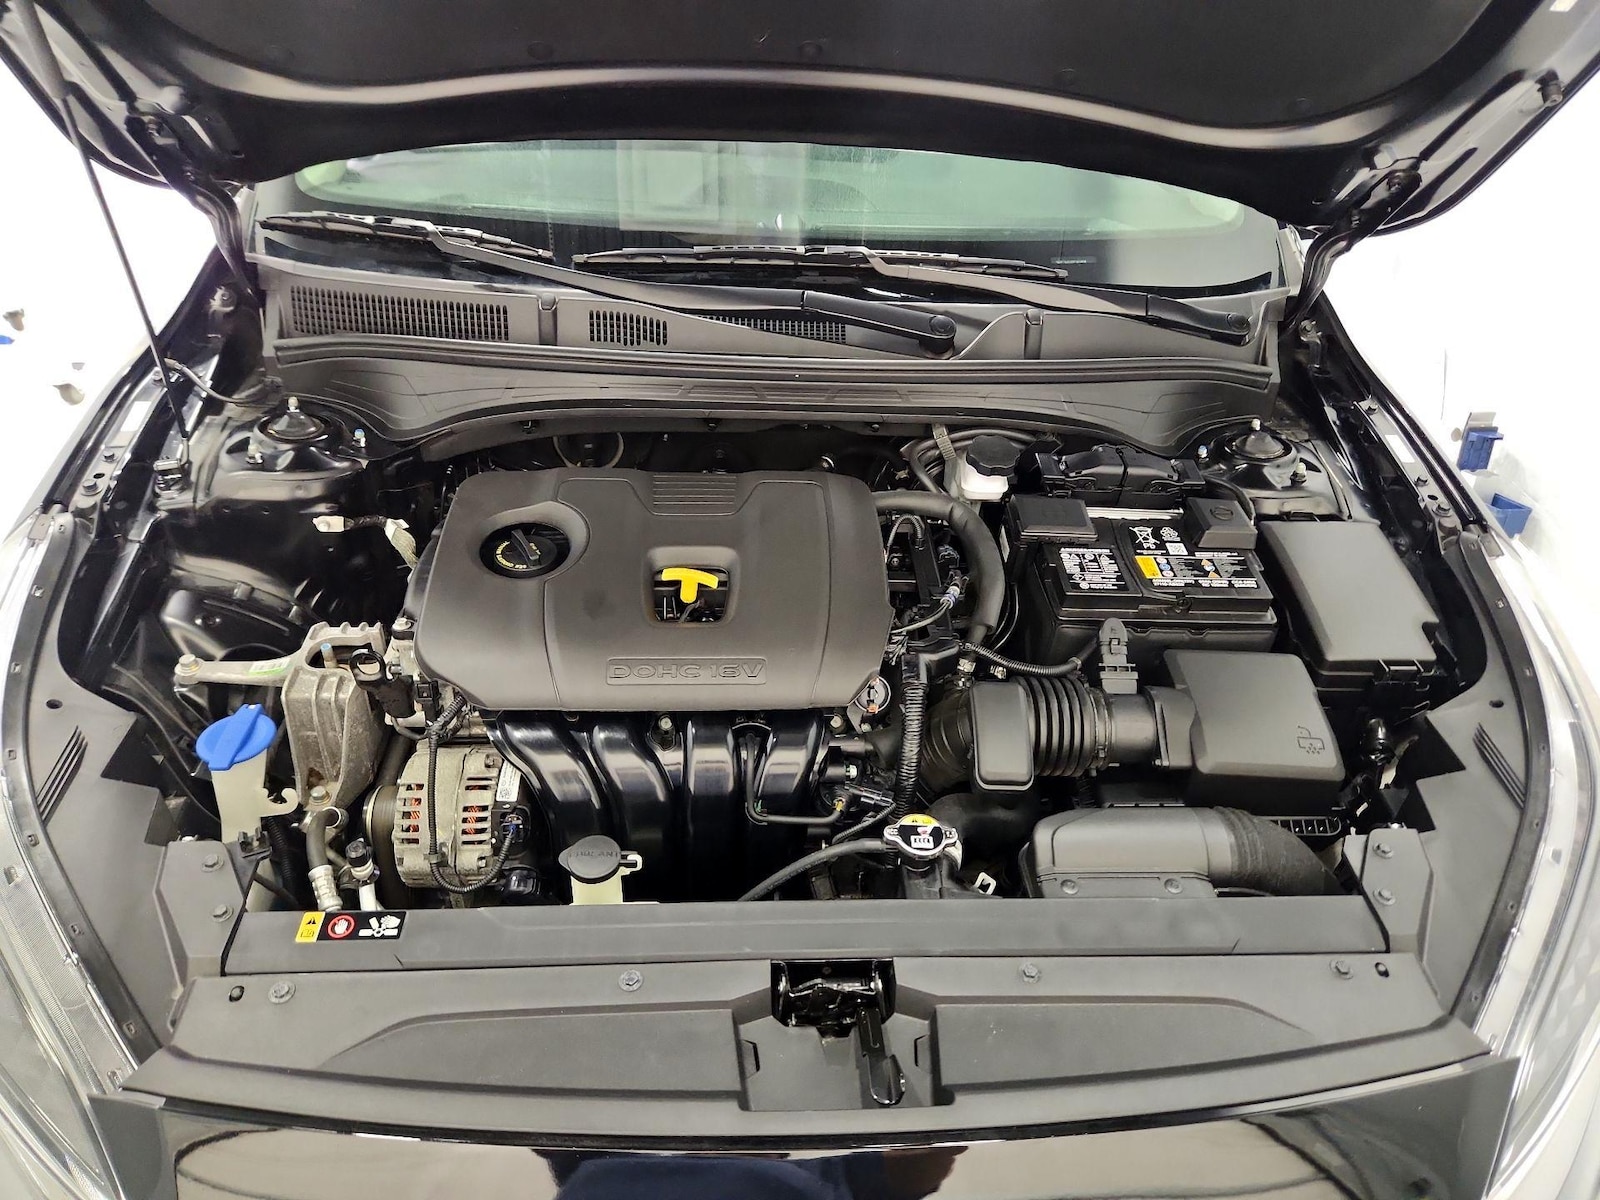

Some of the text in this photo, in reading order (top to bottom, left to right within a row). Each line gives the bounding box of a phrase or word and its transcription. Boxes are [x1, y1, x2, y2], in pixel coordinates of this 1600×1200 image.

[1143, 541, 1156, 549] Pb
[609, 664, 765, 679] DOHC 16V
